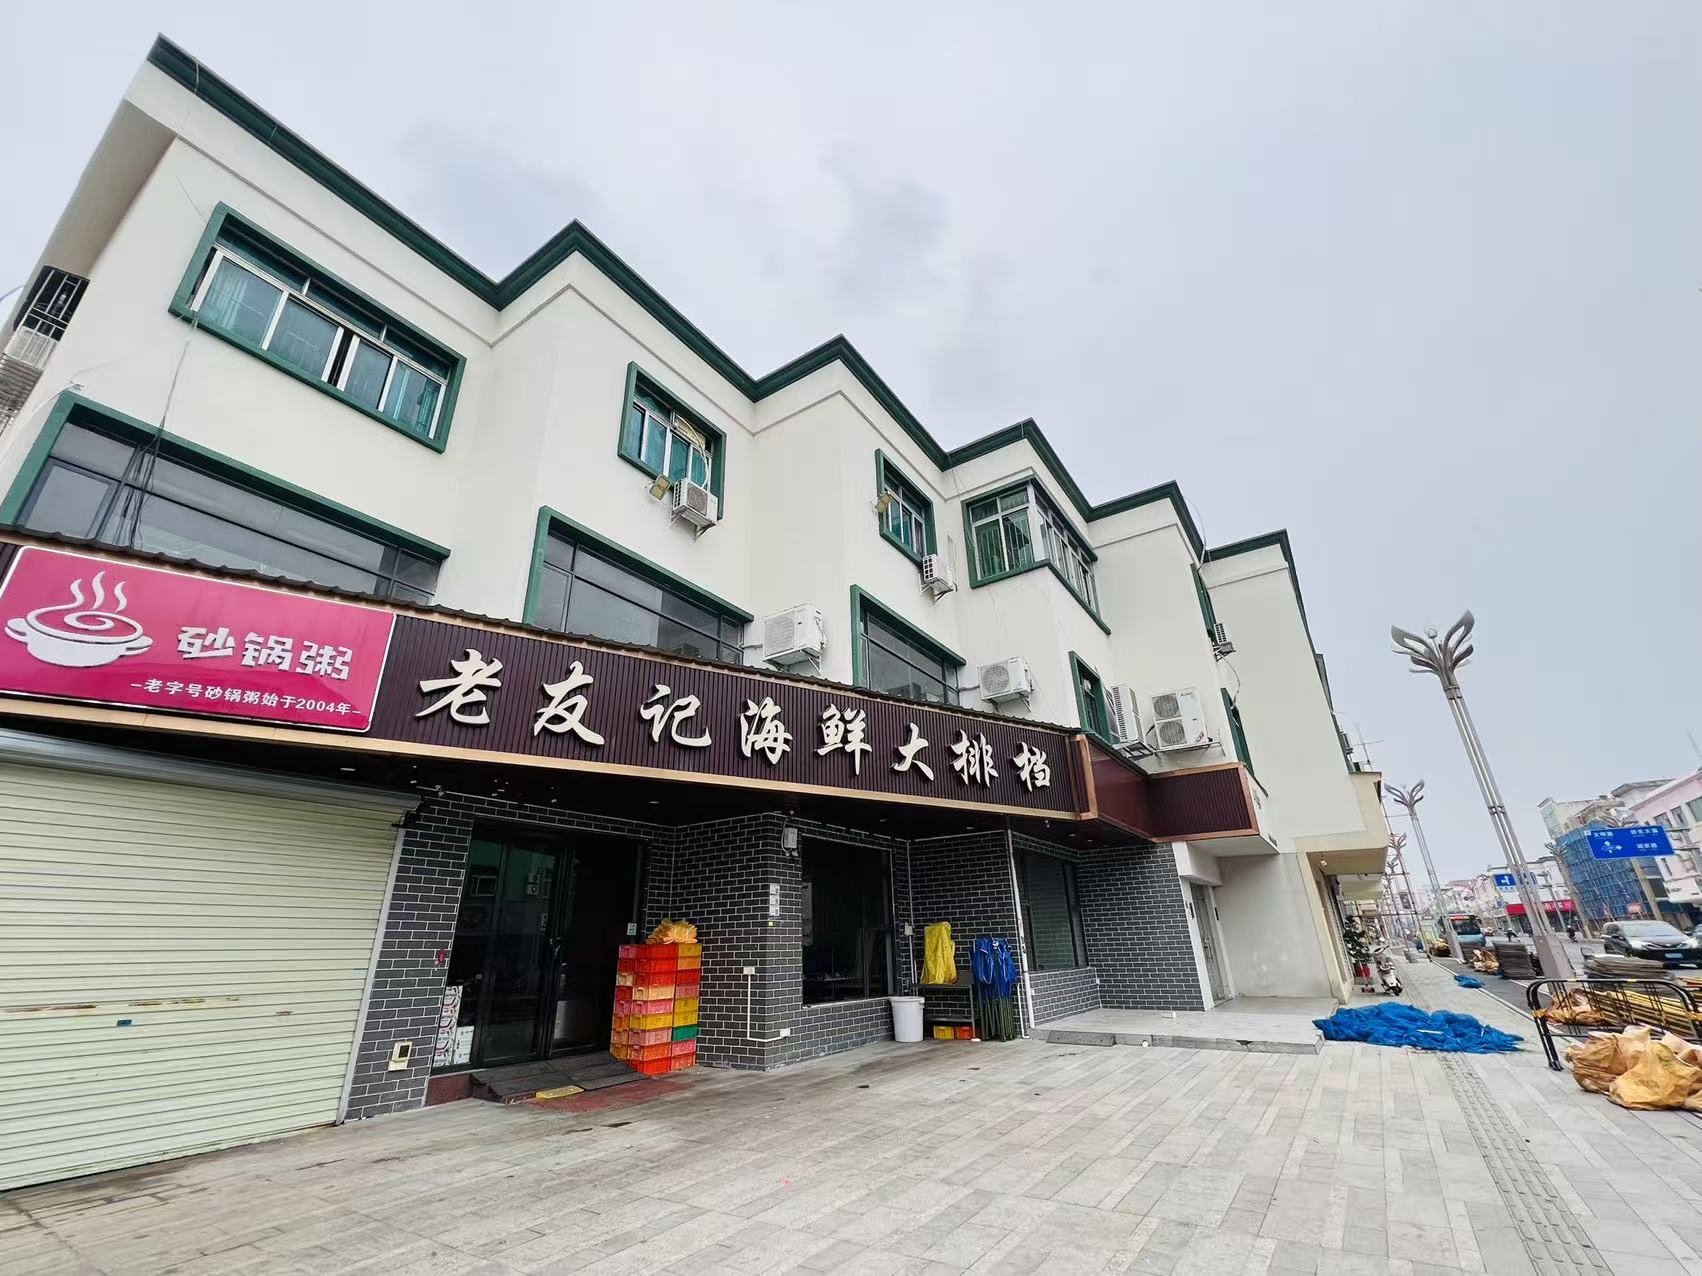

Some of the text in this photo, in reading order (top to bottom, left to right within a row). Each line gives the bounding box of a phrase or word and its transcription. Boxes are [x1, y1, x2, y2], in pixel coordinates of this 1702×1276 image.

[177, 626, 352, 681] 砂锅粥
[415, 648, 1052, 793] 老友记海鲜大排档
